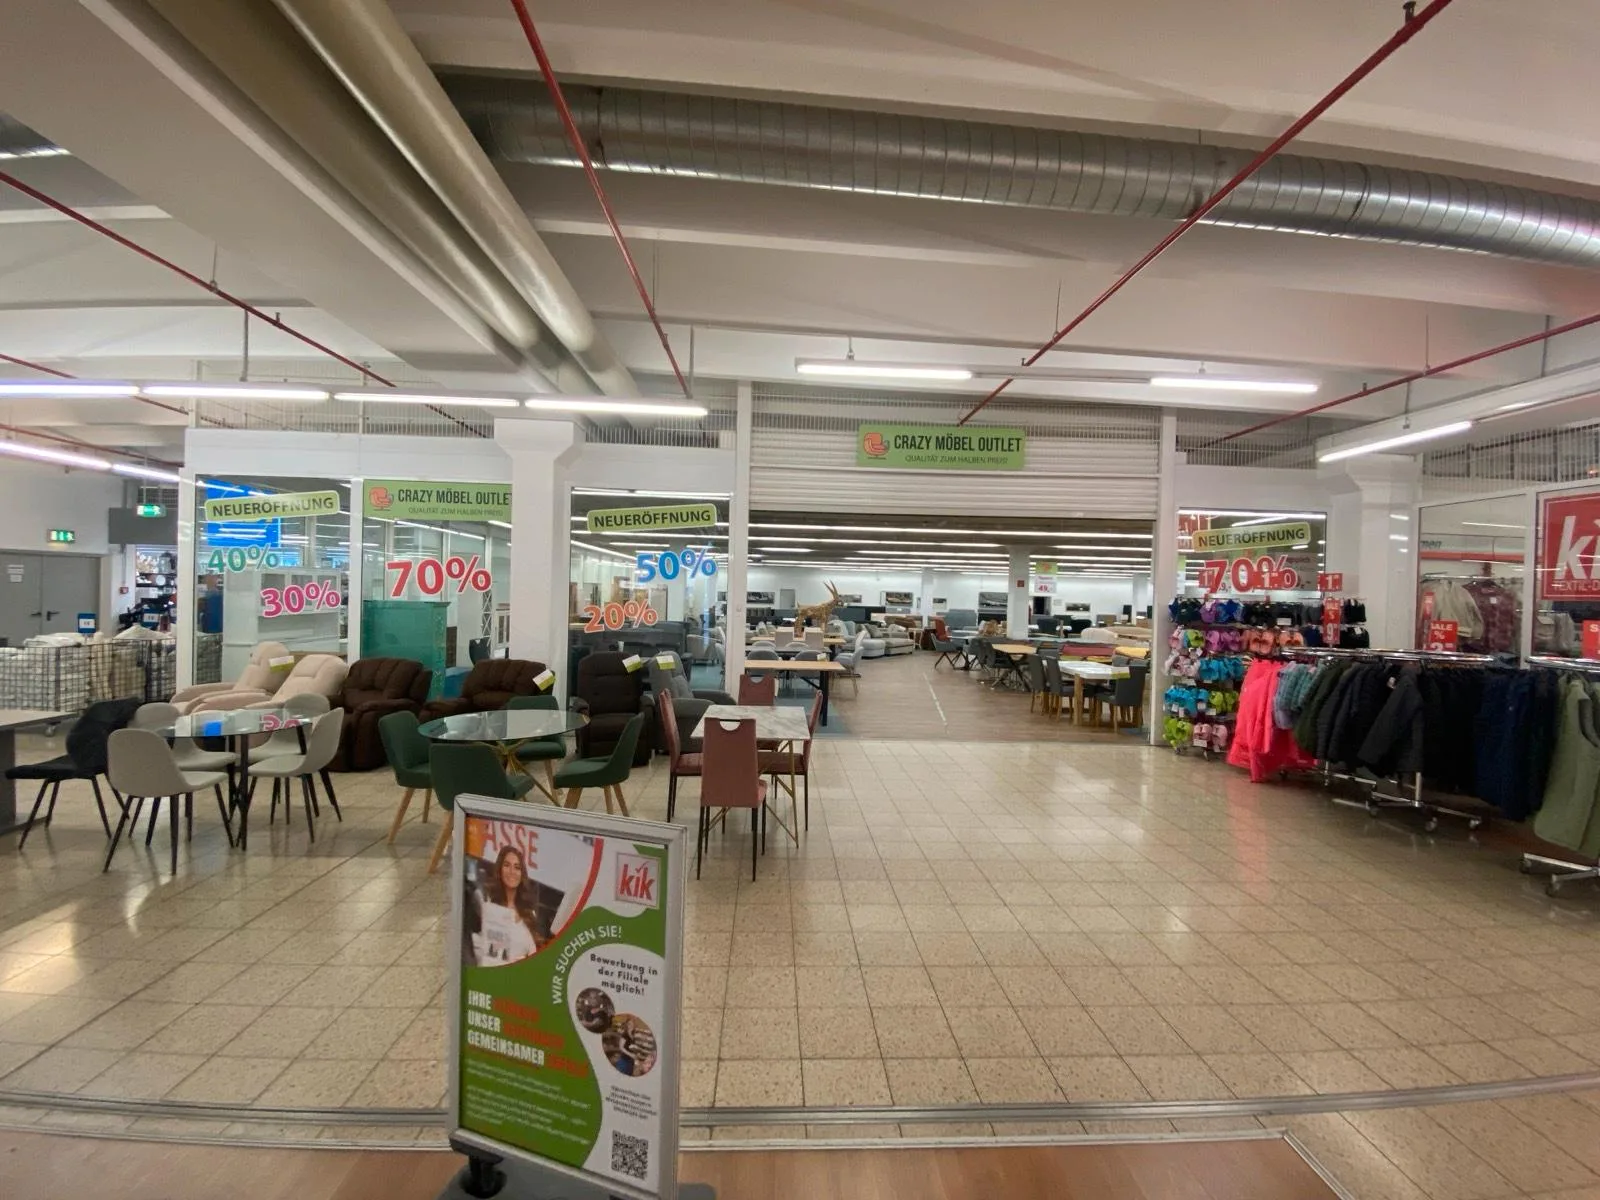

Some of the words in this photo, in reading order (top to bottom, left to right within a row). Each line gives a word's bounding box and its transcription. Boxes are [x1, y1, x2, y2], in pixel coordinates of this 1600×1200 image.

[894, 434, 932, 450] CRAZY
[935, 433, 974, 451] MÖBEL
[978, 436, 1022, 453] OUTLET
[905, 455, 938, 463] QUALITÄT
[957, 456, 985, 464] HALBEN
[212, 496, 334, 517] NEUERÖFFNUNG
[398, 489, 433, 503] CRAZY
[436, 488, 472, 504] MÖBEL
[475, 491, 512, 506] OUTLE
[594, 510, 711, 528] NEUERÖFFNUNG
[1198, 528, 1305, 547] NEUERÖFFNUNG
[207, 542, 279, 573] 40%
[636, 546, 718, 583] 50%
[386, 554, 492, 598] 70%
[1204, 555, 1298, 594] 70%
[260, 579, 341, 618] 30%
[583, 600, 658, 633] 20%
[619, 861, 655, 900] kik
[598, 925, 622, 938] SIE!
[556, 926, 596, 973] SUCHEN
[590, 953, 645, 975] Bewerbung
[648, 968, 658, 976] in
[598, 967, 614, 978] der
[617, 970, 649, 985] Filiale
[551, 975, 563, 1005] WIR
[601, 979, 645, 996] möglich!
[468, 989, 492, 1010] IHRE
[467, 1009, 501, 1033] UNSER
[467, 1029, 545, 1066] GEMEINSAMER
